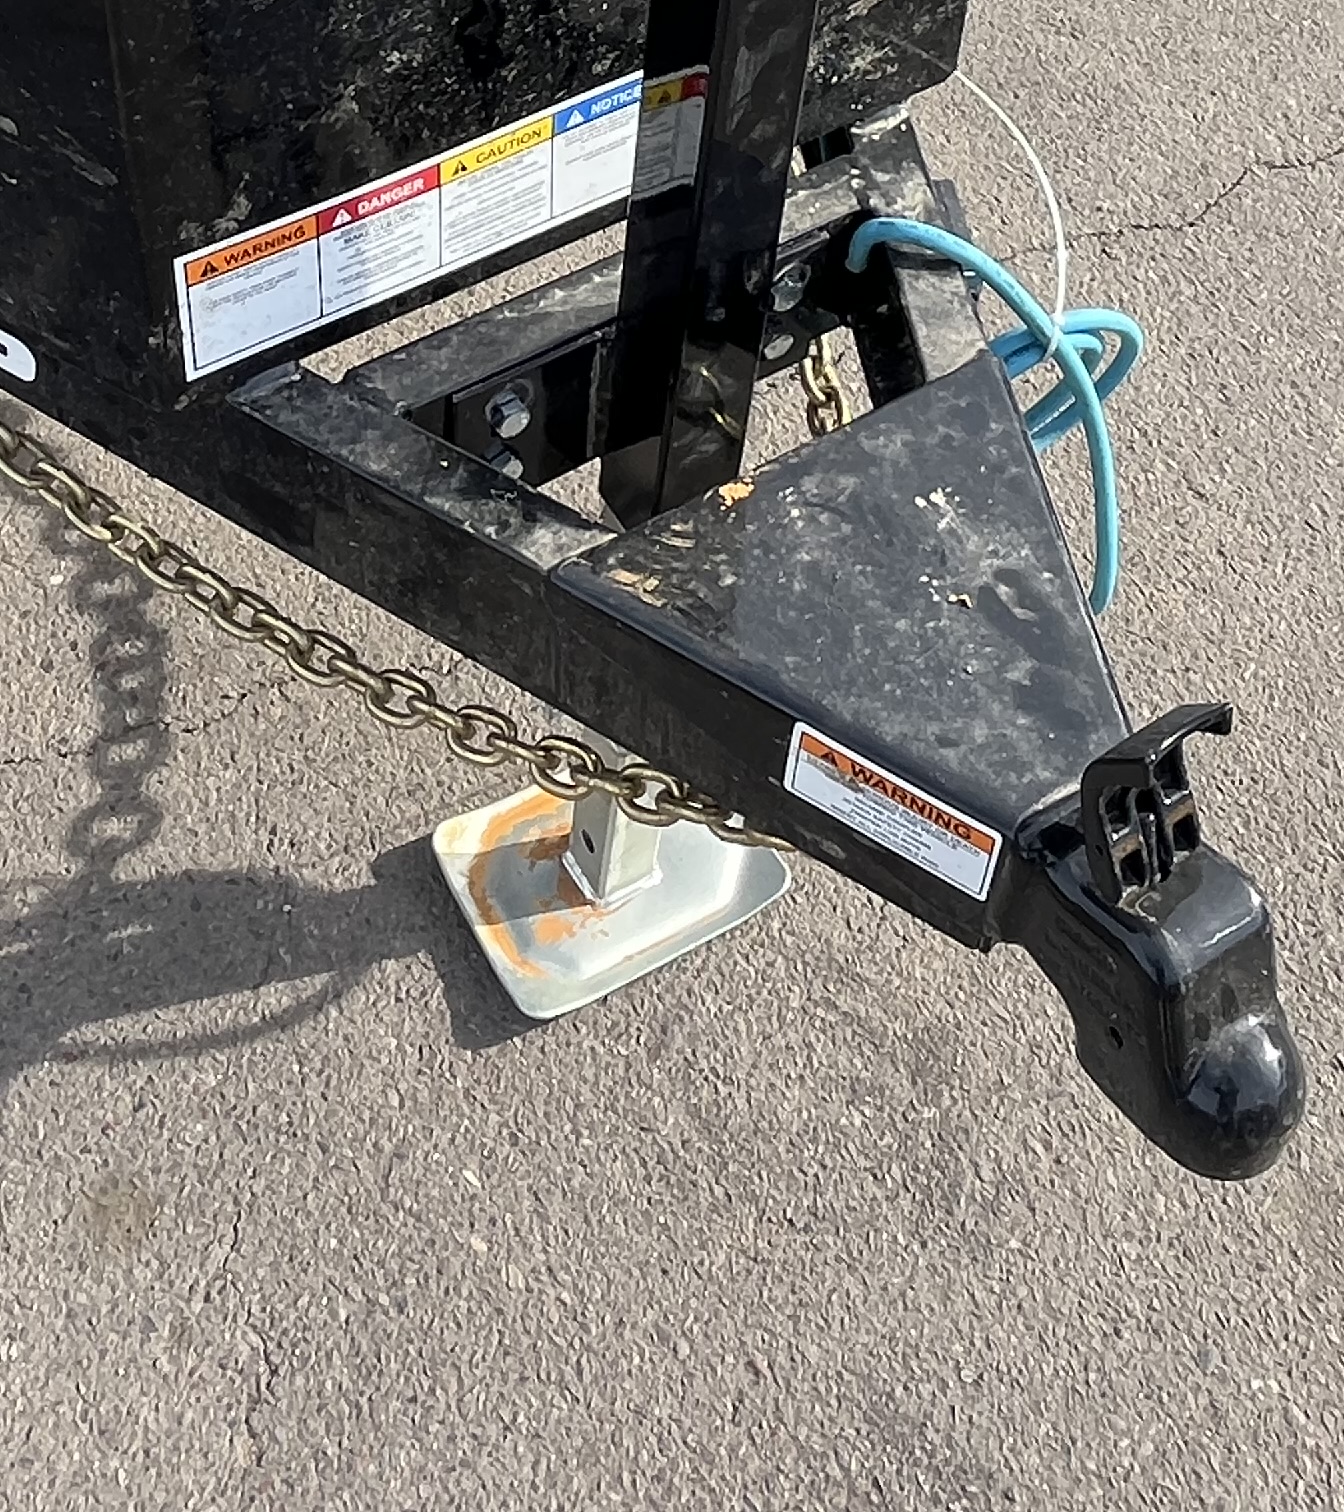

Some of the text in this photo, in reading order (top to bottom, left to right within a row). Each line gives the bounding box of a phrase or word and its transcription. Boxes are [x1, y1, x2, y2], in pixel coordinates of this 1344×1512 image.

[589, 84, 643, 116] NOTICE
[475, 125, 544, 165] CAUTION
[357, 177, 425, 216] DANGER
[222, 224, 307, 267] WARNING
[851, 763, 973, 840] WARNING
